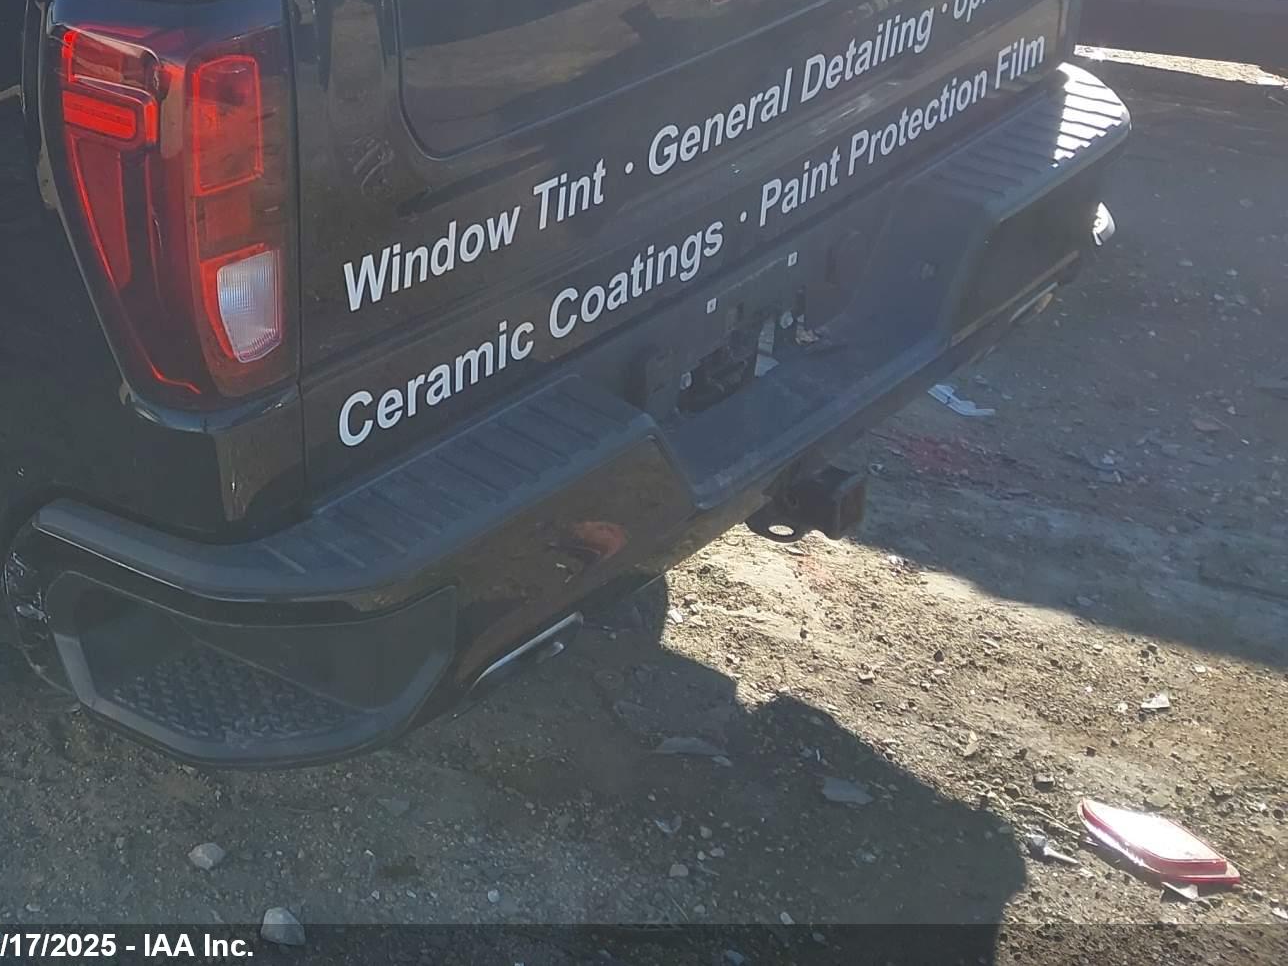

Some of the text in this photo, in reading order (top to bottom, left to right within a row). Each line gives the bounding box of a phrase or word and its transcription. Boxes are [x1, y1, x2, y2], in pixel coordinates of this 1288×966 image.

[338, 34, 1045, 448] Ceramic Coatings Paint Protection Film
[343, 205, 520, 312] Window
[533, 160, 607, 230] Tint
[646, 66, 793, 176] General
[802, 6, 933, 103] Detailing
